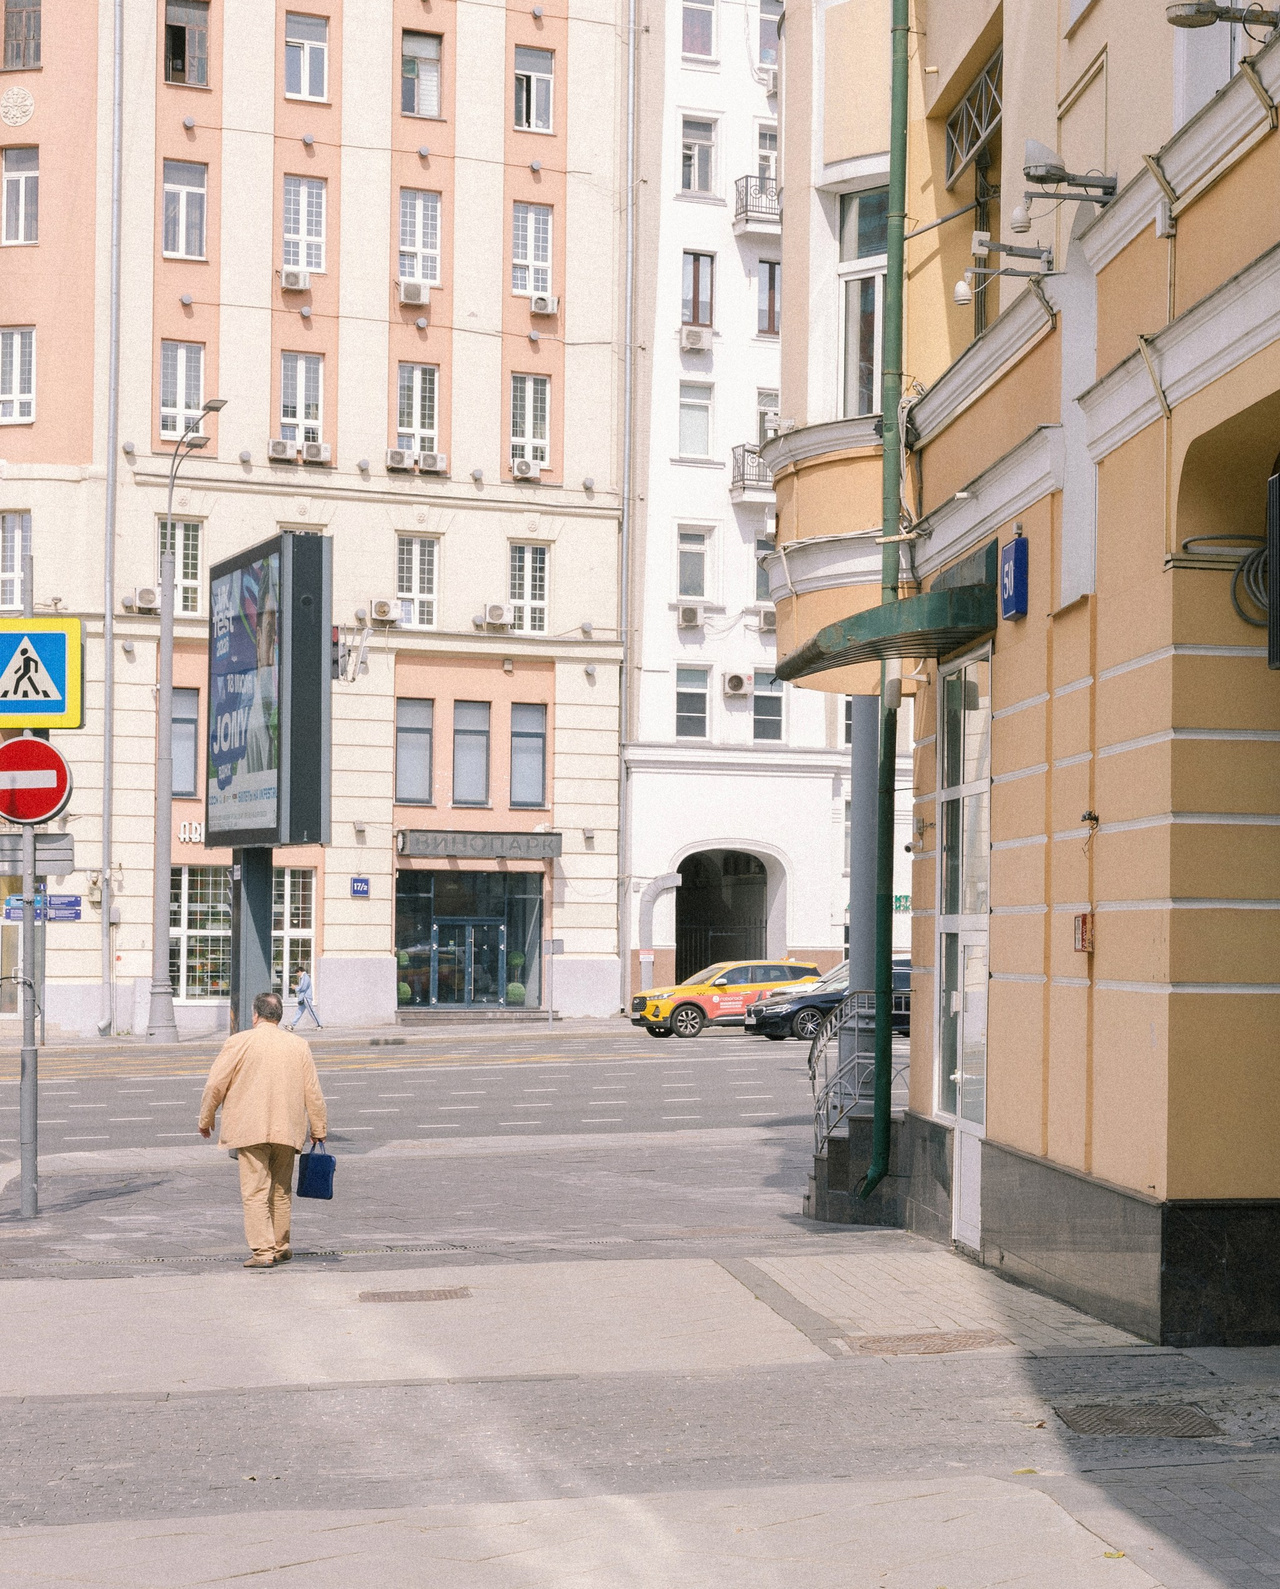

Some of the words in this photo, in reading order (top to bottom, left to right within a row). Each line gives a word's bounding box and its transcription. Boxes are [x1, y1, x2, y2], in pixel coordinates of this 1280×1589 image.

[1003, 560, 1014, 599] 50
[415, 833, 555, 853] ВИНОПАРК
[353, 882, 368, 892] 17/2
